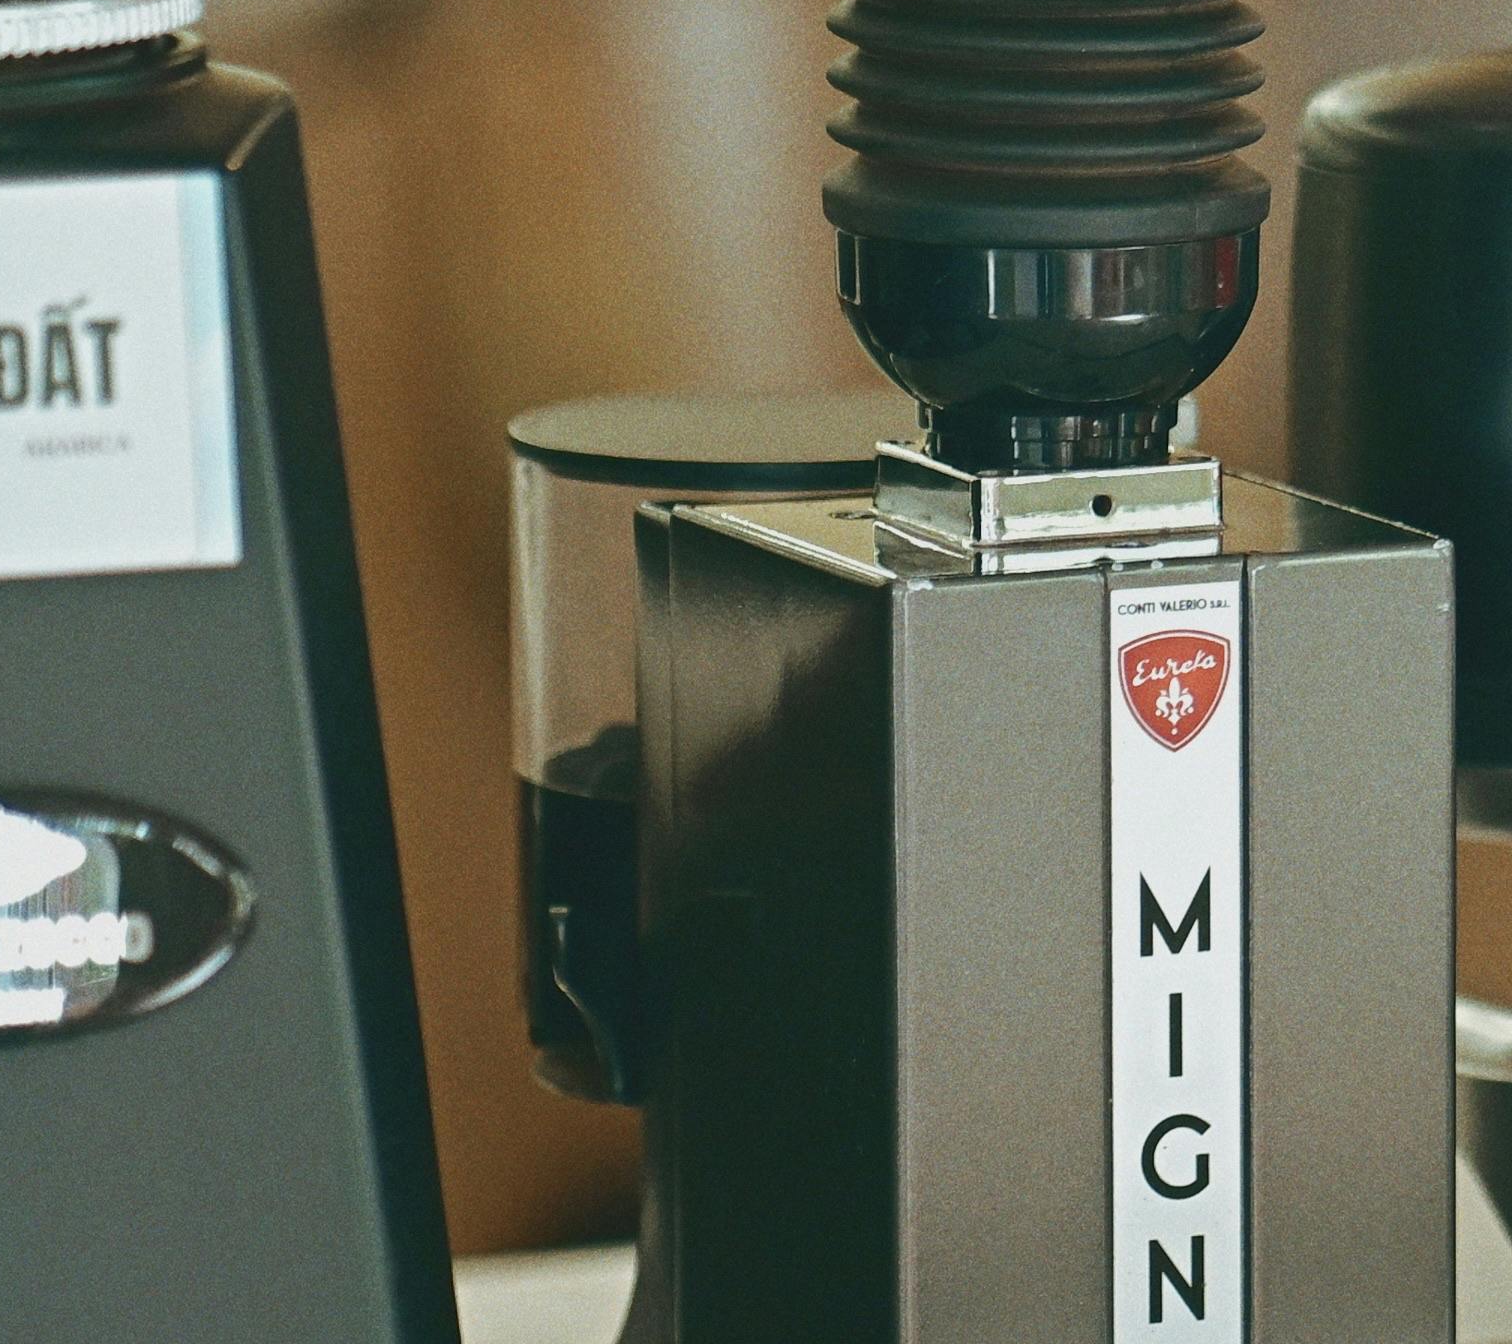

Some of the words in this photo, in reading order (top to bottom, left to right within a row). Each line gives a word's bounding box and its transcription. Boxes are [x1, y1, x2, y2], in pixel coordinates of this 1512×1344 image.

[1118, 602, 1155, 616] CONTI
[1160, 598, 1207, 612] VALERIO
[1132, 649, 1217, 687] Eureka
